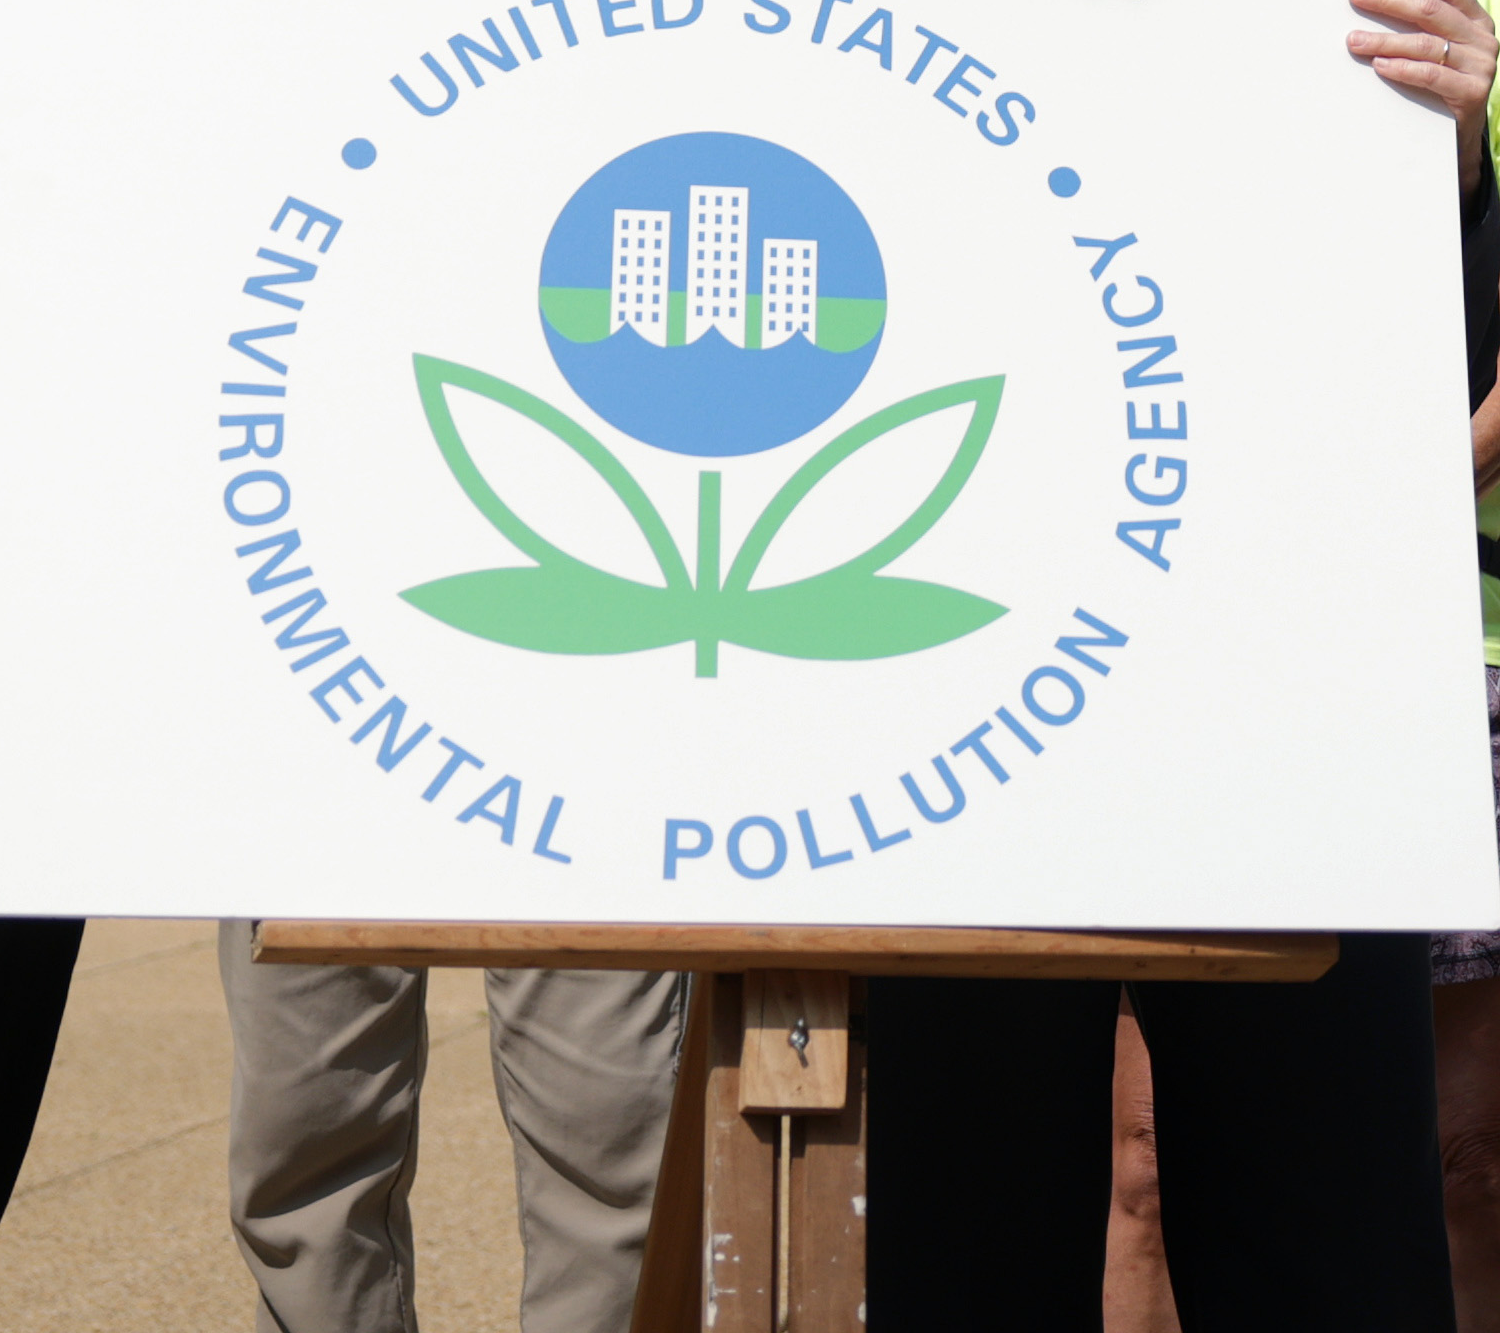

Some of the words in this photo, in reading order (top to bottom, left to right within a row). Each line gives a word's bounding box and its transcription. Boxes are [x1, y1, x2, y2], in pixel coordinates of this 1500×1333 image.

[219, 196, 572, 864] ENVIRONMENTAL
[664, 608, 1129, 880] POLLUTION
[1074, 233, 1188, 572] AGENCY
